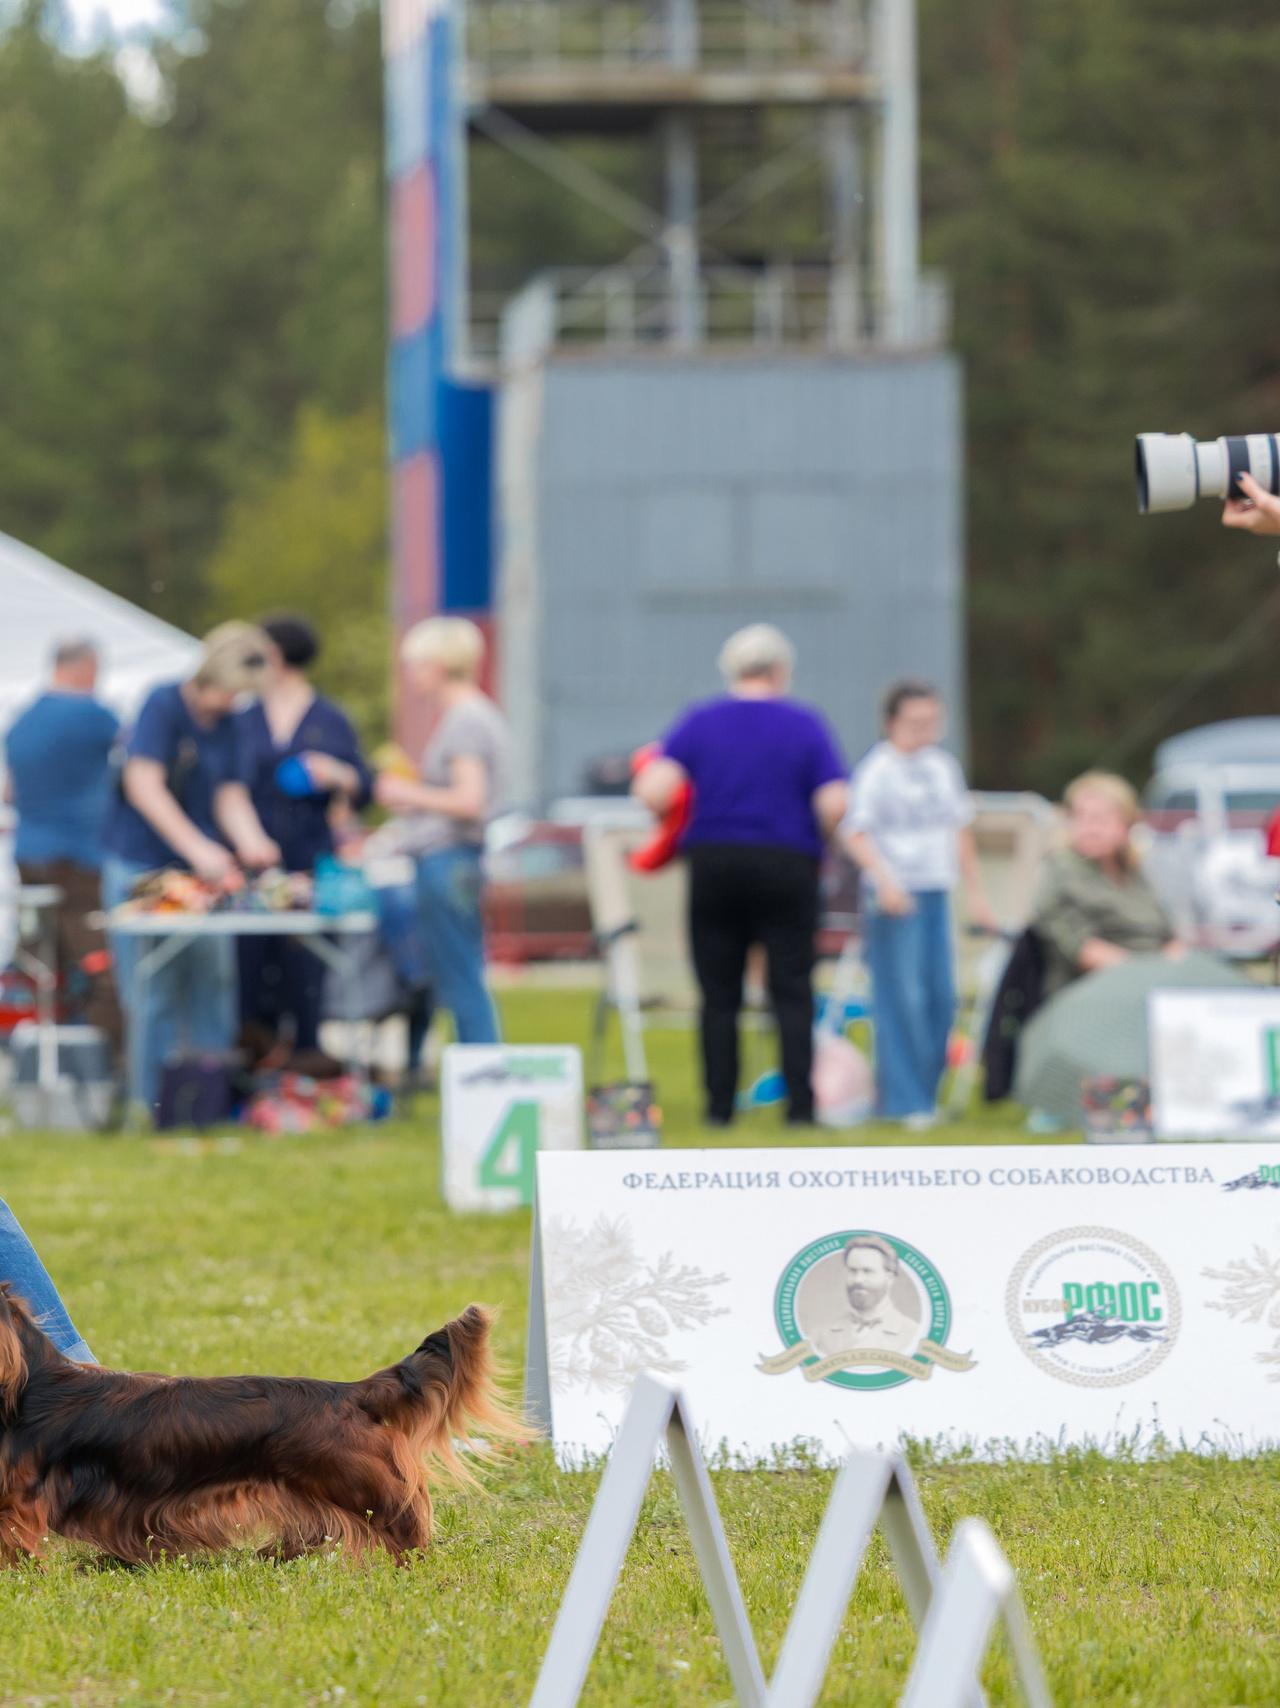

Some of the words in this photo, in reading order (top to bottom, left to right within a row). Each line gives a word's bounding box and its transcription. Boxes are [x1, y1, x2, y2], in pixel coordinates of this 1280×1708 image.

[479, 1097, 539, 1208] 4
[622, 1171, 781, 1191] ФЕДЕРАЦИЯ
[788, 1169, 981, 1189] ОХОТНИЧЬЕГО
[989, 1166, 1215, 1186] СОБАКОВОДСТВА
[1062, 1280, 1162, 1323] РФОС
